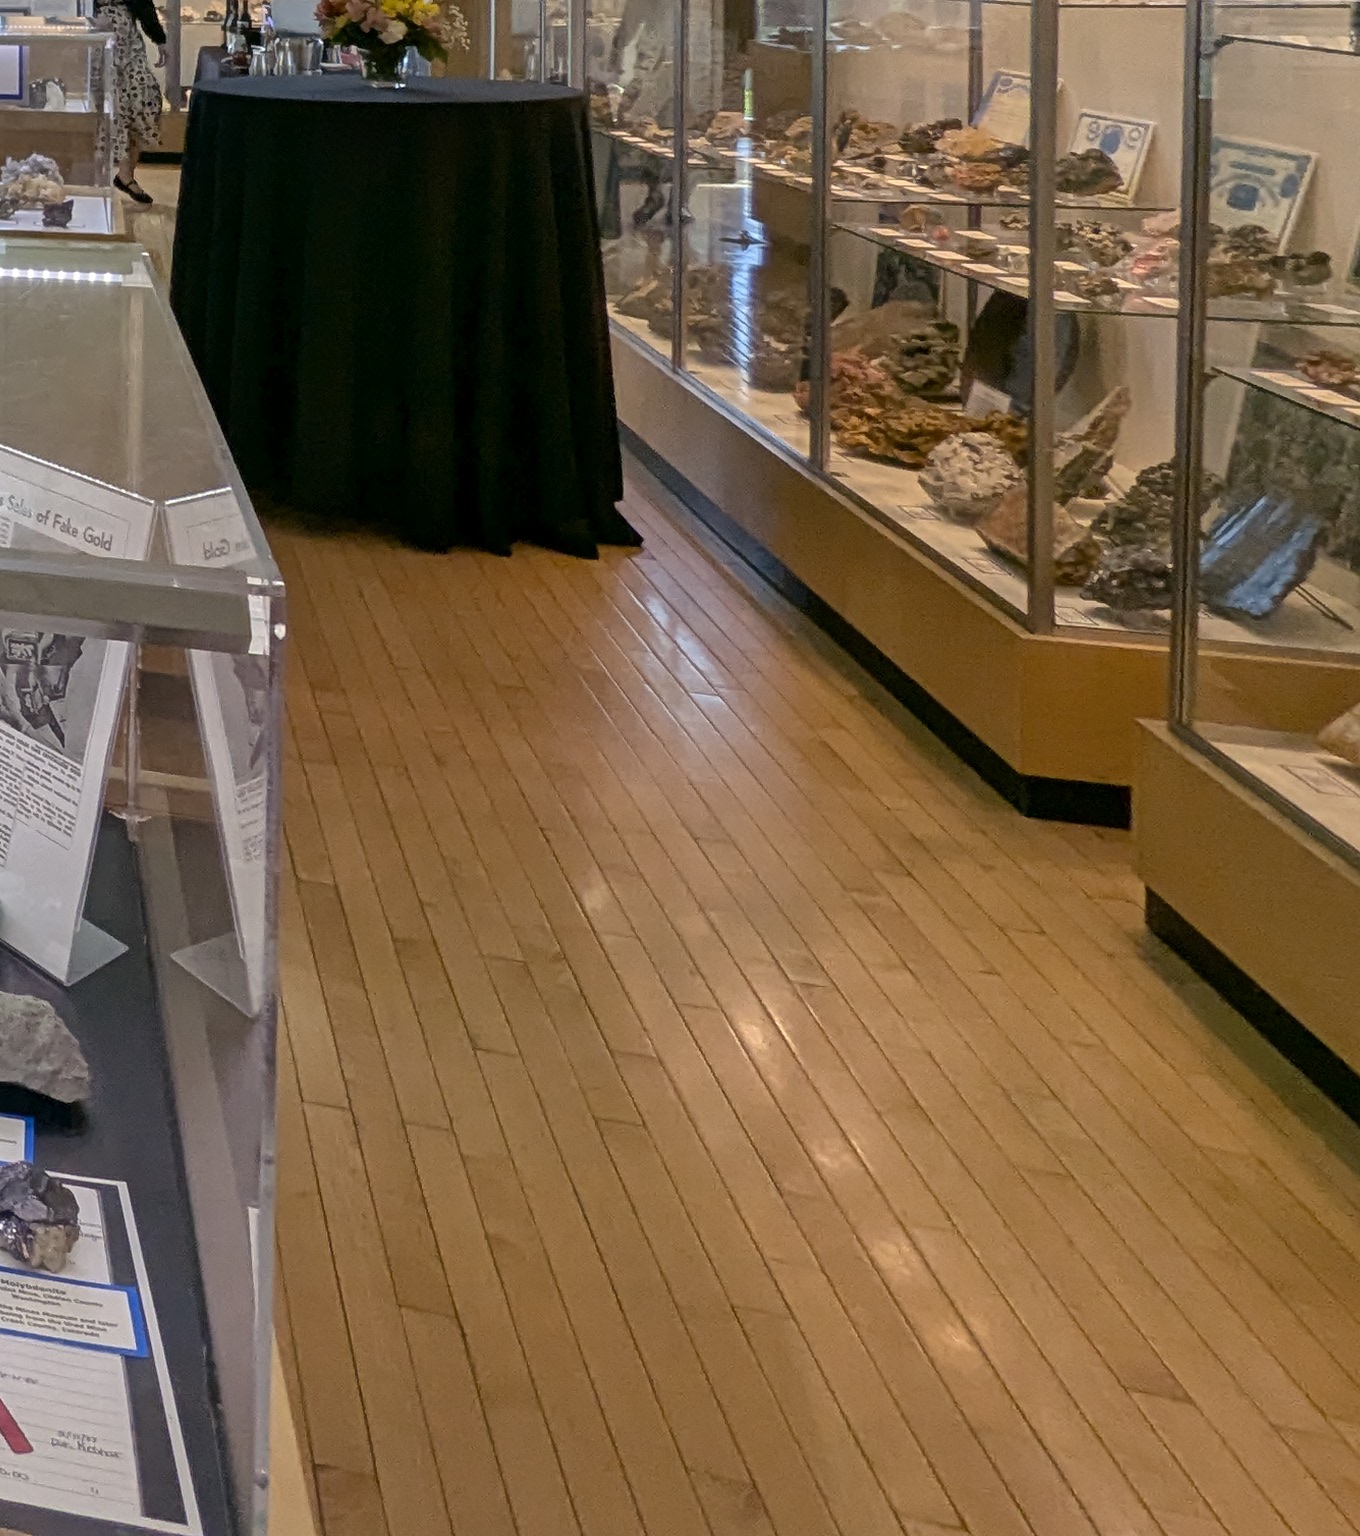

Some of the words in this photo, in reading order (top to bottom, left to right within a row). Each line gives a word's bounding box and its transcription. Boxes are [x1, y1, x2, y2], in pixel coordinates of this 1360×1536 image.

[7, 495, 32, 518] Sales
[37, 510, 51, 525] of
[53, 515, 78, 537] Fake
[84, 526, 113, 552] Gold
[1, 1279, 66, 1295] Molybdenite
